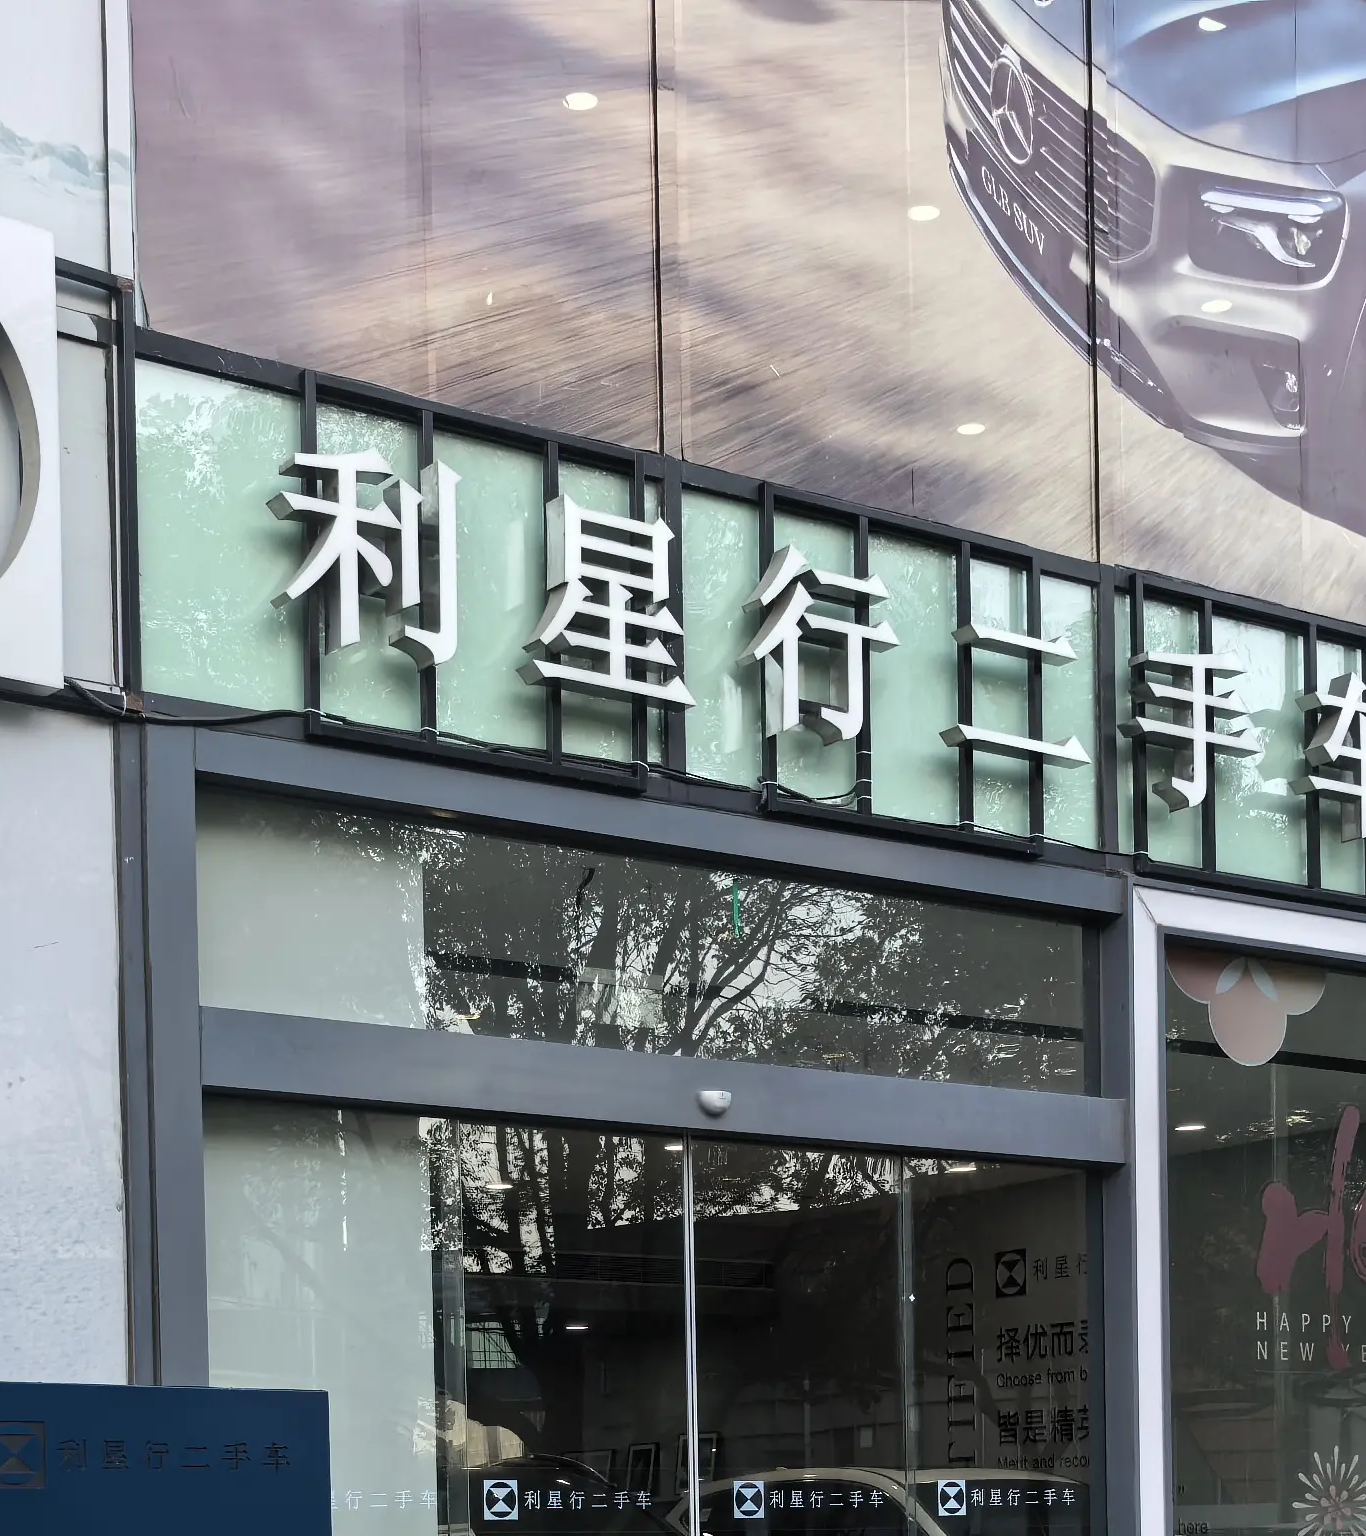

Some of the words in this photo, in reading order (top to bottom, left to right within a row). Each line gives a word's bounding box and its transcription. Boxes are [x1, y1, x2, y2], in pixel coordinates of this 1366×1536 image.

[982, 166, 1011, 216] GLB
[1013, 202, 1045, 255] SUV
[1256, 1311, 1353, 1334] HAPPY
[1256, 1340, 1315, 1361] NEW
[997, 1372, 1042, 1388] Choose
[1047, 1367, 1075, 1385] from
[56, 1437, 291, 1474] 利星行二手车
[1032, 1453, 1055, 1469] and
[1059, 1452, 1090, 1468] reco
[523, 1489, 652, 1511] 利星行二手车
[769, 1489, 884, 1509] 利星行二手车
[970, 1487, 1077, 1507] 利星行二手车
